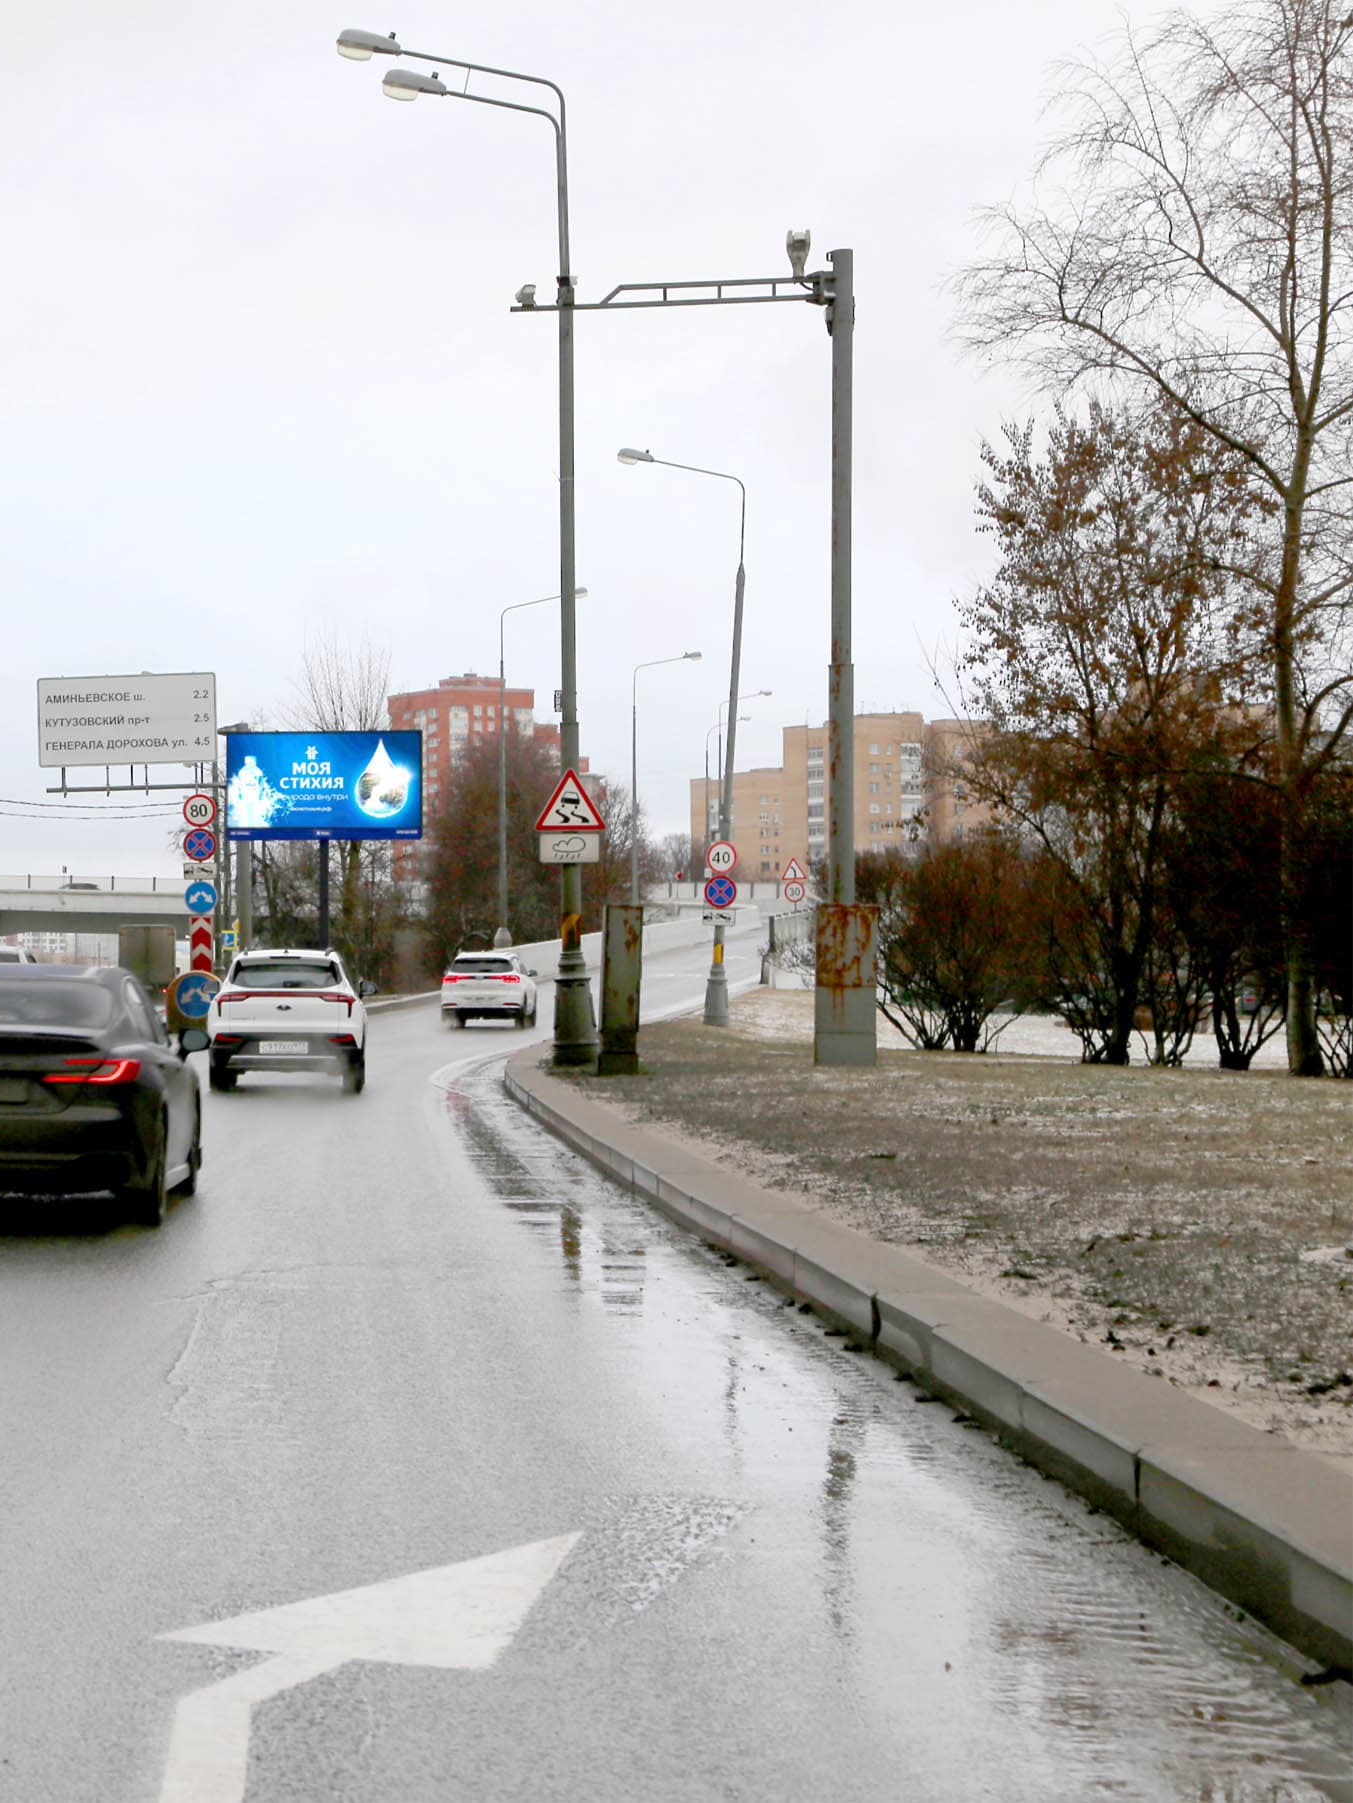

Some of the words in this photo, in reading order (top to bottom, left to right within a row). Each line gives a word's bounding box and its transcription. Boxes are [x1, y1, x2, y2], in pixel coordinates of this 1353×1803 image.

[45, 692, 131, 704] АМИНЬЕВСКОЕ
[134, 694, 146, 702] ш.
[193, 689, 209, 700] 2.2
[45, 715, 125, 728] КУТУЗОВСКИЙ
[127, 717, 151, 727] пр-т
[193, 714, 210, 723] 2.5
[45, 740, 104, 751] ГЕНЕРАЛА
[106, 738, 169, 750] ДОРОХОВА
[171, 739, 188, 750] ул.
[194, 737, 210, 747] 4.5
[291, 761, 331, 776] МОЯ
[279, 776, 344, 790] СТИХИЯ
[190, 804, 208, 818] 80
[711, 851, 731, 864] 40
[789, 887, 801, 897] 30
